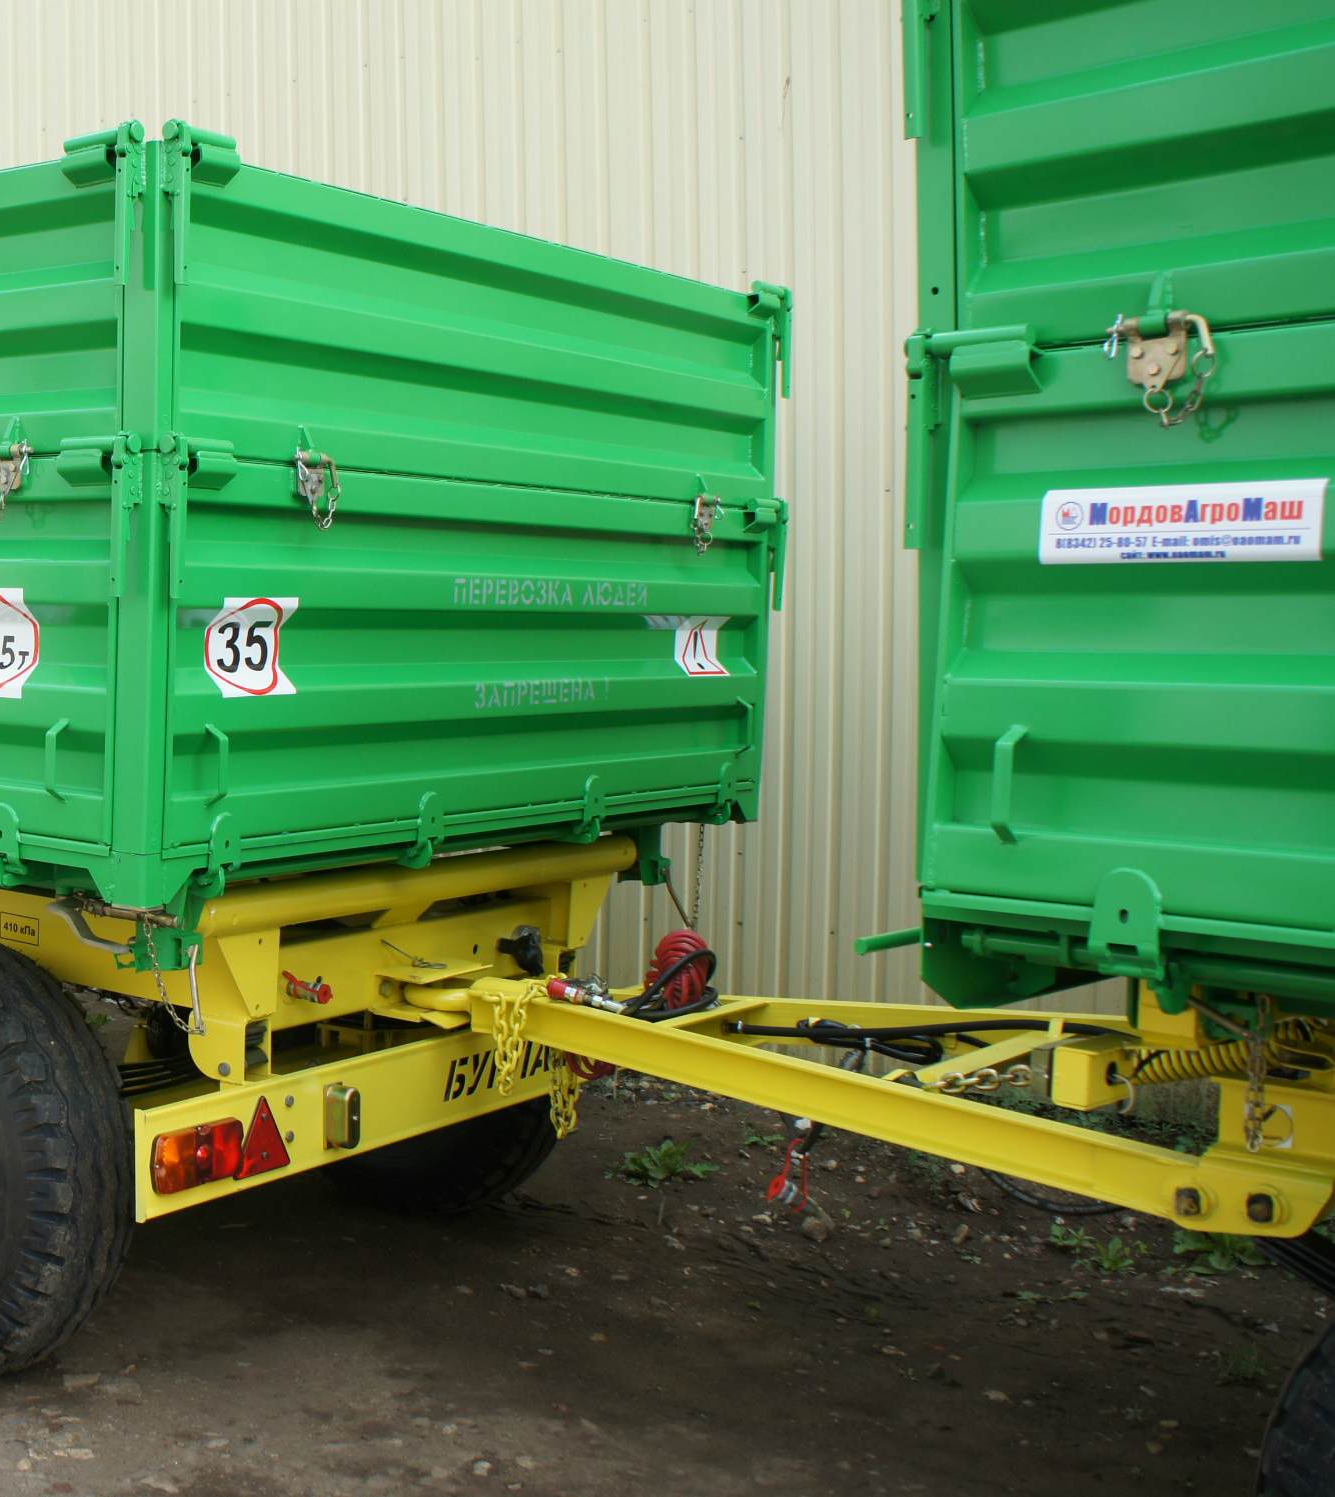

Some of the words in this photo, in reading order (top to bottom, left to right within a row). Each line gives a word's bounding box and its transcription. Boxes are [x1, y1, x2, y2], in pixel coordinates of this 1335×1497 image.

[1089, 498, 1304, 527] МордовАгроМаш
[453, 577, 573, 606] ПЕРЕВОЗКА
[216, 620, 273, 674] 35
[474, 676, 595, 709] ЗАПРЕЩЕНА
[3, 921, 18, 933] 410
